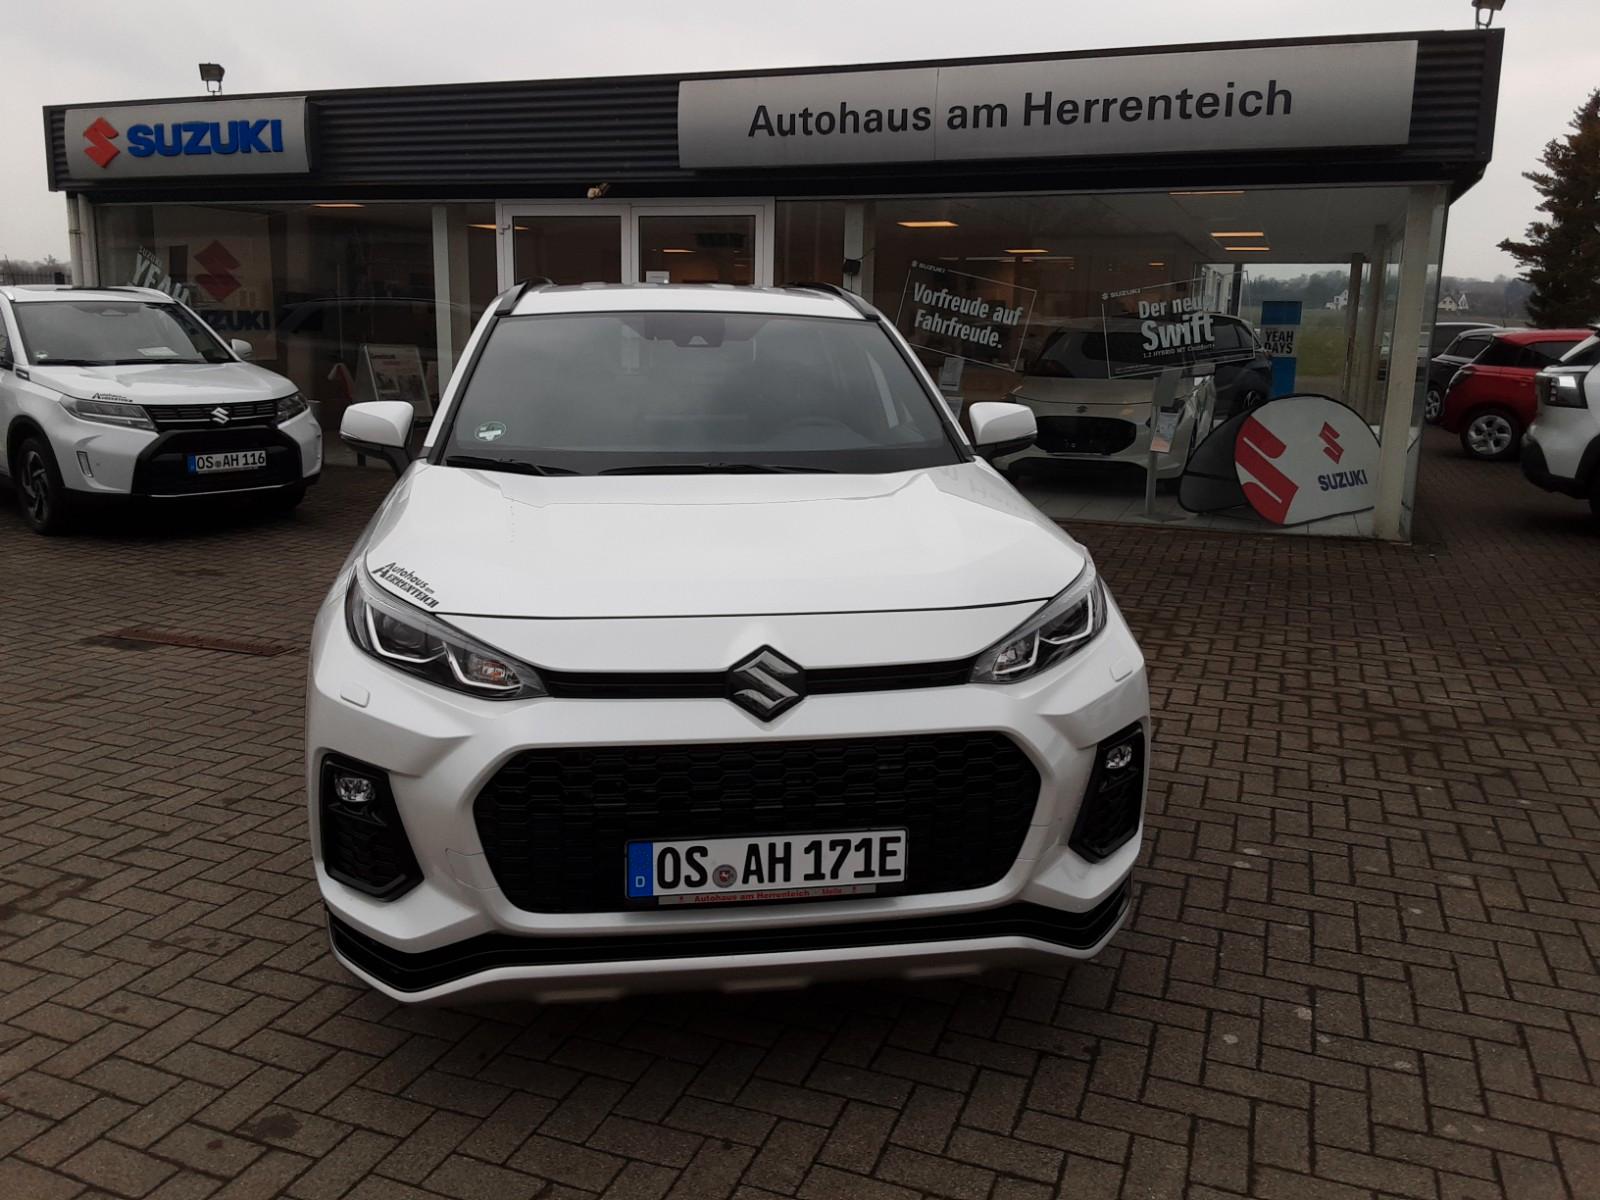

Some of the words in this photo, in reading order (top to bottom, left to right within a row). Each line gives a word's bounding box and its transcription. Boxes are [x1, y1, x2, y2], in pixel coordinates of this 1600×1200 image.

[747, 101, 933, 138] Autohaus
[946, 100, 1009, 131] am
[1022, 80, 1294, 127] Herrenteich
[127, 119, 283, 157] SUZUKI
[914, 281, 990, 319] Vorfreude
[992, 305, 1024, 326] auf
[1138, 300, 1167, 319] Der
[914, 308, 1003, 349] Fahrfreude.
[1141, 312, 1216, 351] Swift
[1265, 330, 1294, 342] YEAH
[1264, 342, 1293, 354] DAYS
[197, 456, 214, 469] OS
[223, 454, 239, 467] AH
[242, 452, 266, 466] 116
[1318, 469, 1368, 491] SUZUKI
[656, 846, 708, 889] OS
[741, 841, 792, 884] AH
[803, 836, 901, 881] 171E
[635, 876, 645, 888] D
